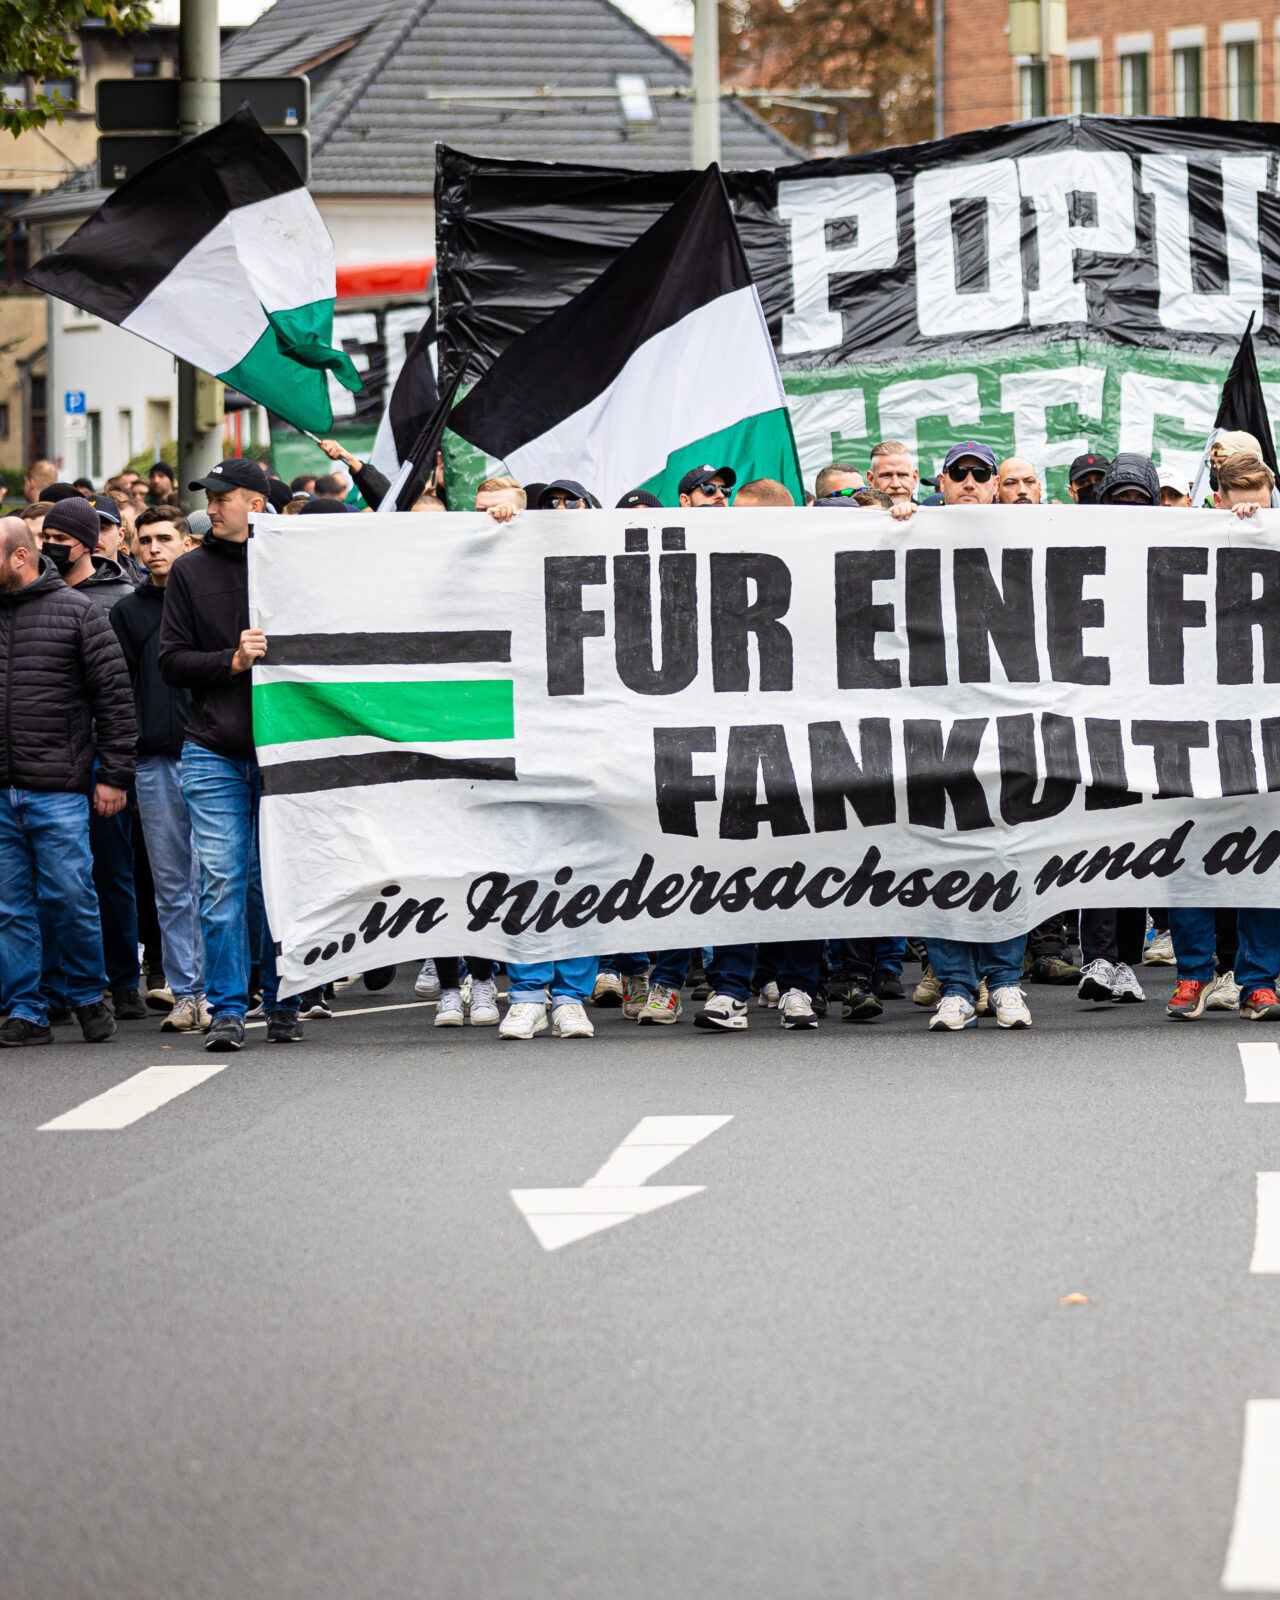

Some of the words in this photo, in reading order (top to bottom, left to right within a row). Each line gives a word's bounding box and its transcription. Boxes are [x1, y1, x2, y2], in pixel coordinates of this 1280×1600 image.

[544, 527, 794, 696] FÜR
[834, 546, 1111, 690] EINE
[303, 884, 449, 966] ...in
[465, 845, 1021, 936] Niedersachsen
[1033, 819, 1196, 896] und
